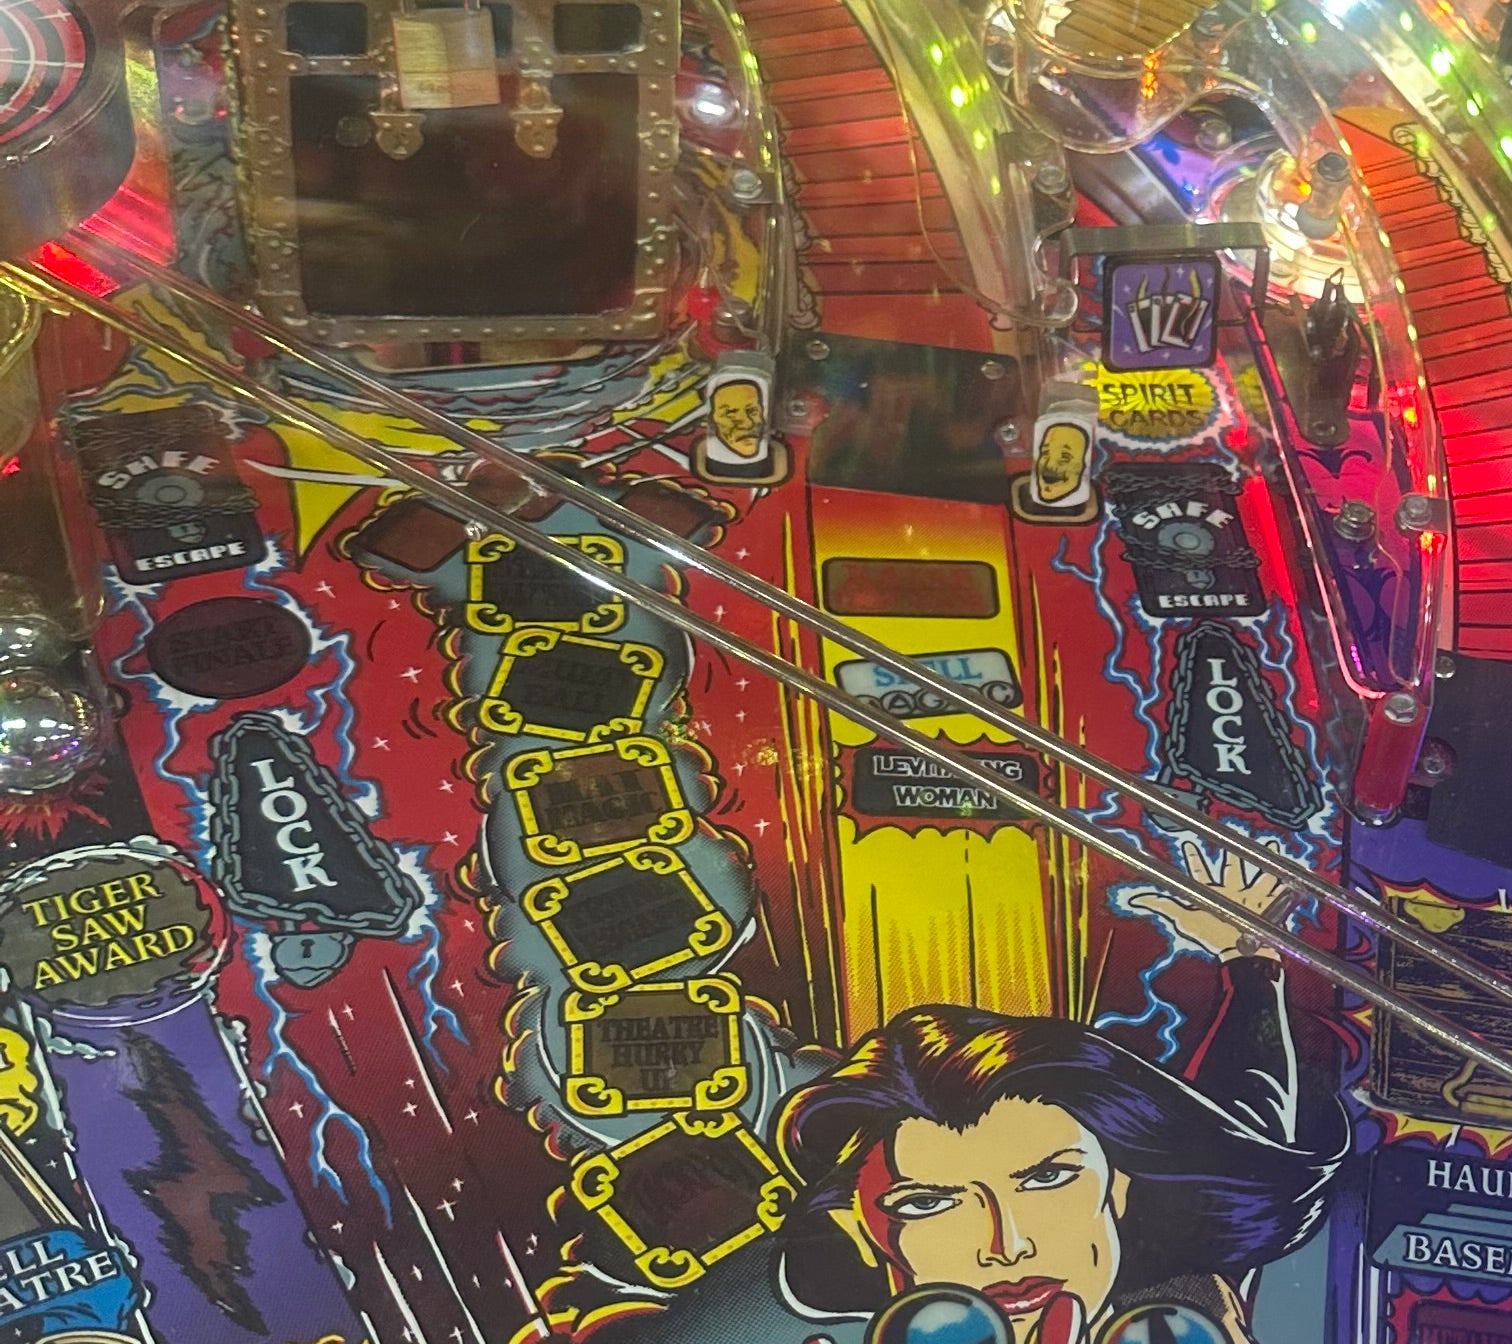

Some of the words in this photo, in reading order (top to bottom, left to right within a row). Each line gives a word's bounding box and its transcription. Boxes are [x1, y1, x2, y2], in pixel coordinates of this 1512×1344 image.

[1102, 383, 1196, 408] SPIRIT
[1108, 410, 1201, 429] CARDS
[1132, 500, 1235, 530] SAFE
[135, 541, 248, 572] ESCAPE
[1157, 593, 1250, 610] ESCAPE
[873, 657, 983, 687] SLL
[1205, 658, 1251, 776] LOCK
[893, 785, 998, 810] WOMAN
[250, 757, 338, 893] LOCK
[22, 870, 165, 928] TIGER
[51, 905, 149, 954] SAW
[33, 923, 195, 991] AWARD
[597, 1014, 719, 1043] THEATRE
[611, 1039, 706, 1068] HURRY
